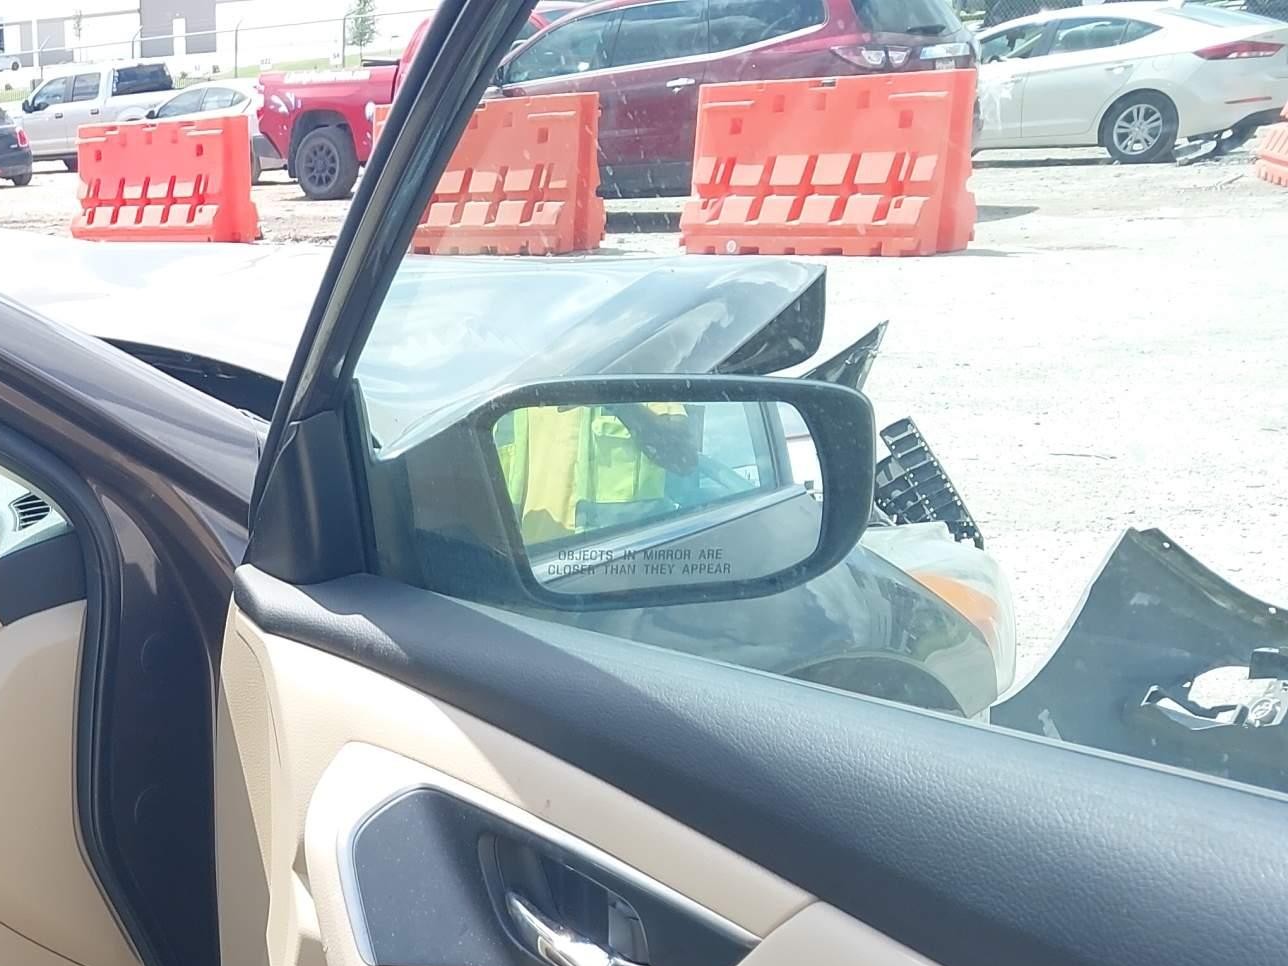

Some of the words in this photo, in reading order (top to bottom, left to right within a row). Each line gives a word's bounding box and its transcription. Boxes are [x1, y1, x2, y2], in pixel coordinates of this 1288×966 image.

[558, 550, 614, 561] OBJECTS
[623, 550, 636, 561] IN
[643, 549, 691, 560] MIRROR
[698, 549, 723, 560] ARE
[548, 564, 596, 576] CLOSER
[604, 564, 636, 576] THAN
[644, 564, 674, 575] THEY
[682, 563, 731, 575] APPEAR
